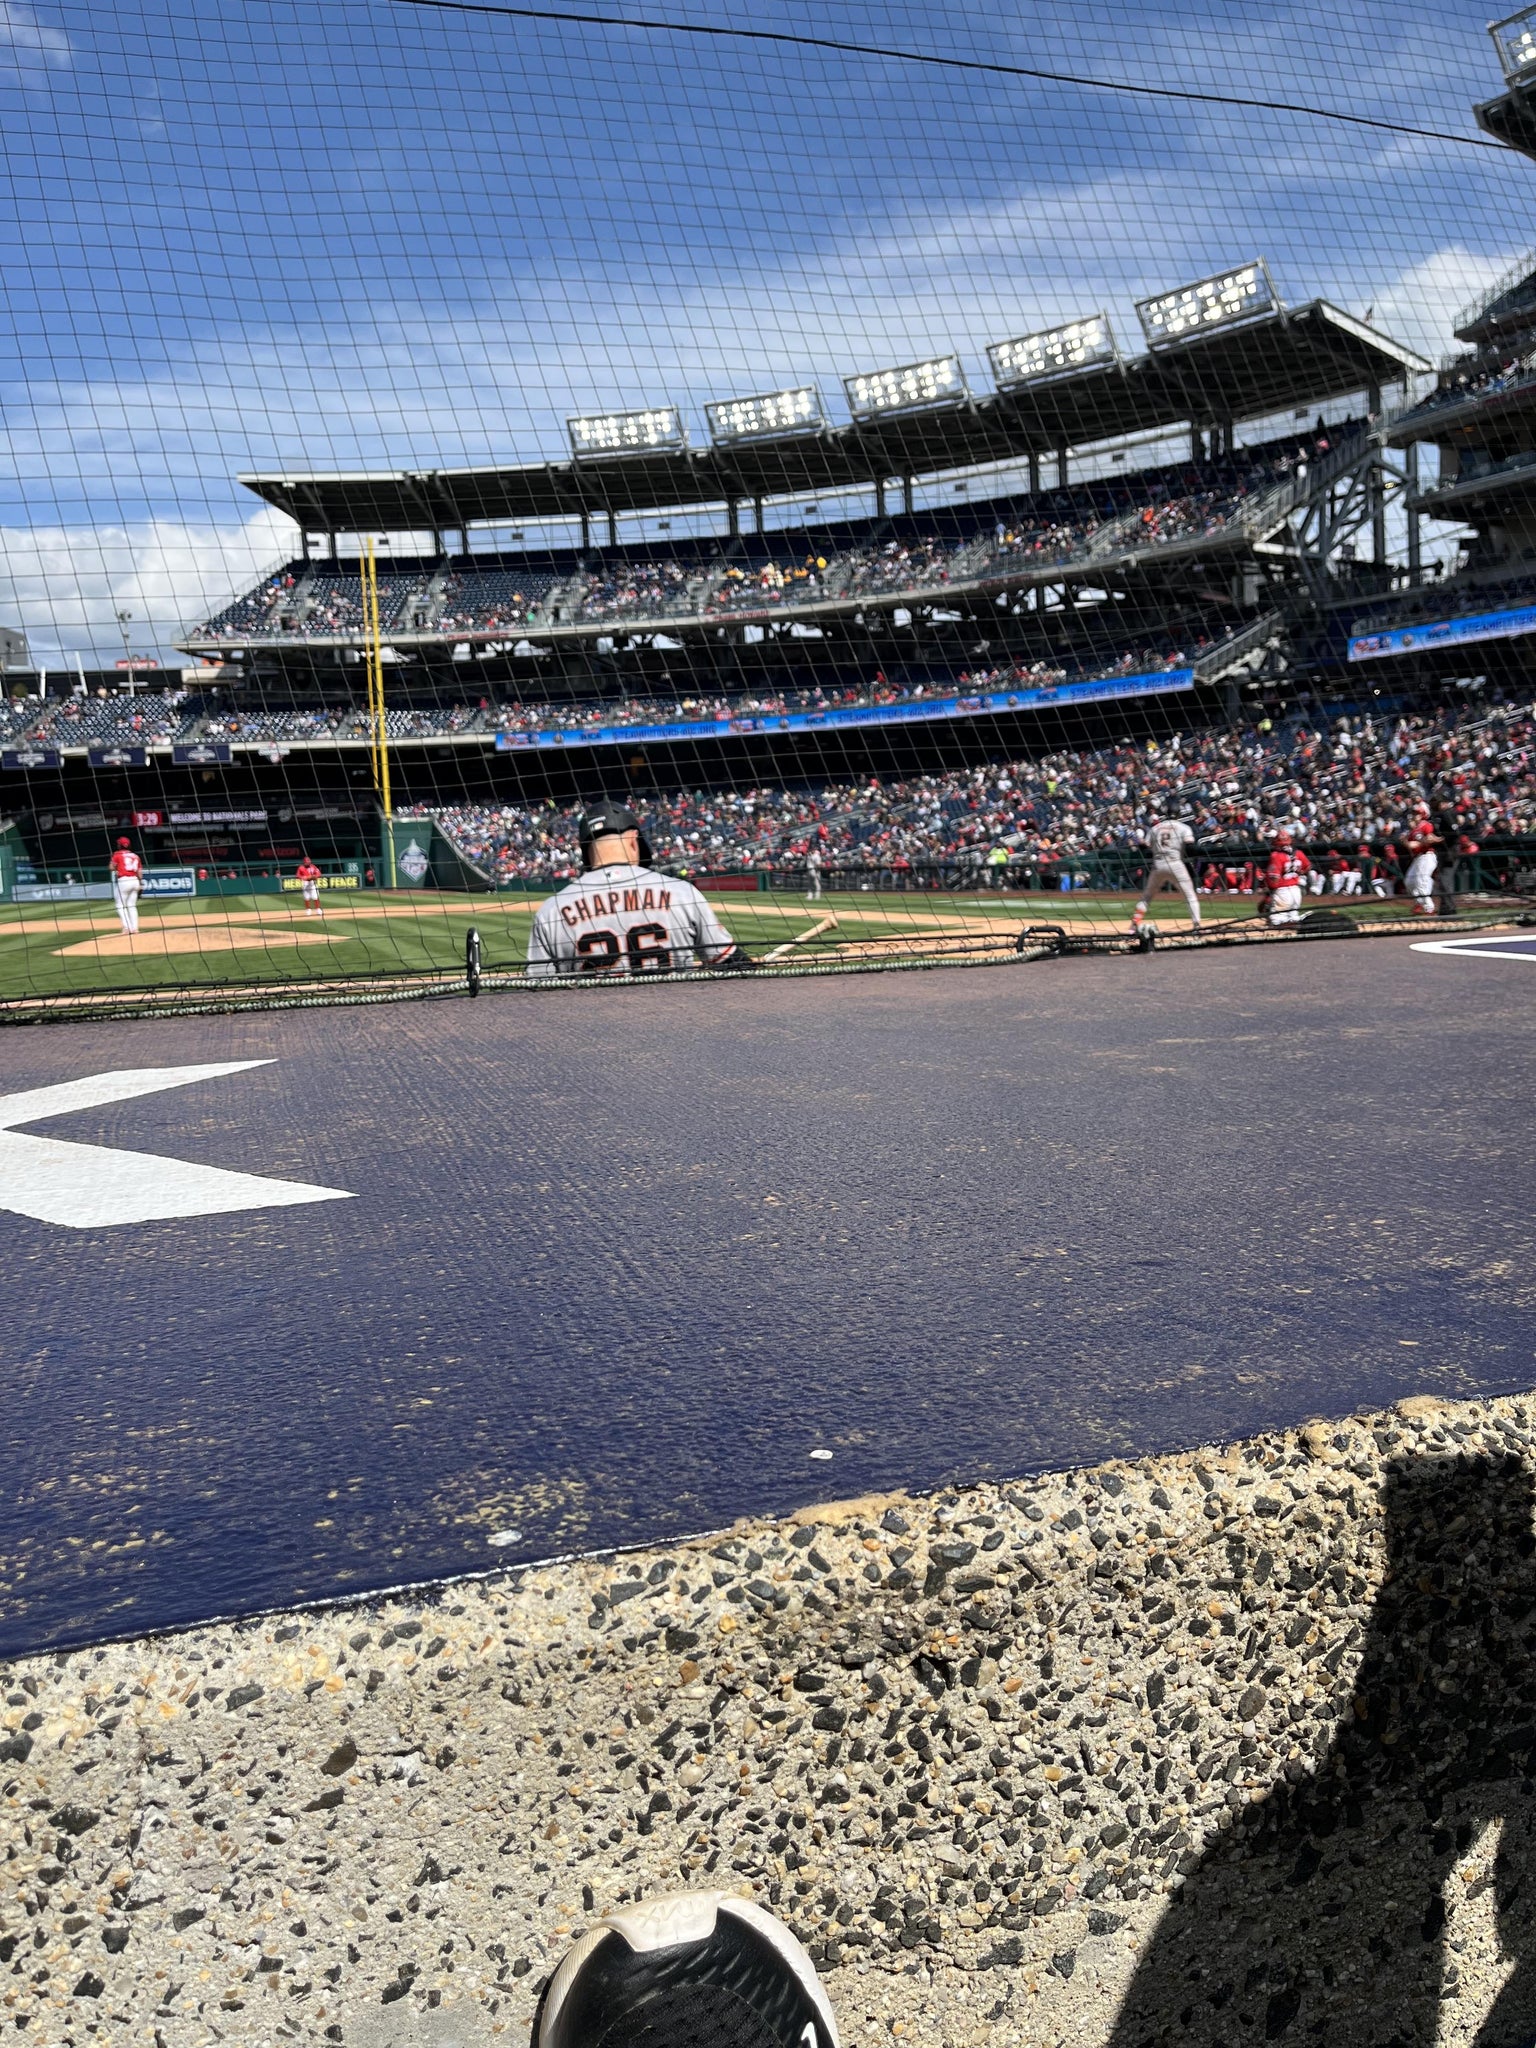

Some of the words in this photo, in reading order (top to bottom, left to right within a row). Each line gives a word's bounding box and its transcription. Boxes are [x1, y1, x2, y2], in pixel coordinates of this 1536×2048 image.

[170, 812, 202, 824] WELCOME
[202, 812, 212, 822] TO
[212, 811, 249, 822] NATIONALS
[249, 809, 268, 821] PARK
[283, 878, 328, 889] HERES
[329, 876, 357, 888] FENCE
[560, 888, 671, 927] CHAPMAN
[576, 922, 672, 975] 26
